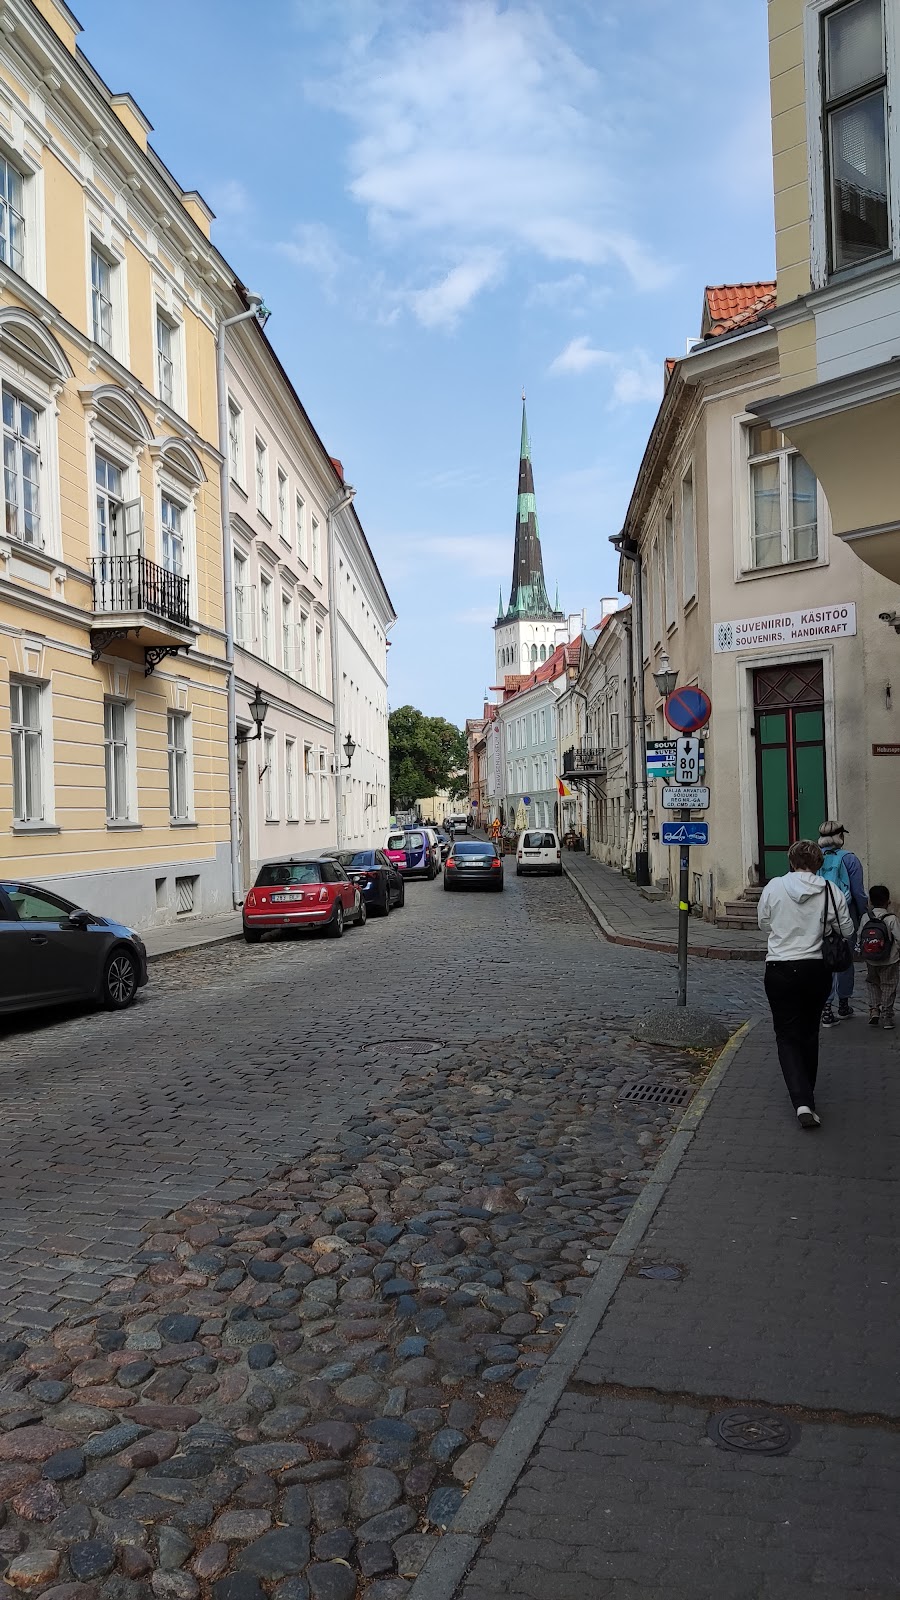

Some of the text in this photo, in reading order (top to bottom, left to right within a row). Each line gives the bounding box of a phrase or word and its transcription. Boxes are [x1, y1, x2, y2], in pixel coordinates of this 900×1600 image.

[735, 606, 848, 634] SUVENIIRID, KÄSITÖÖ
[791, 622, 848, 639] HANDIKRAFT
[680, 758, 695, 769] 80
[682, 771, 692, 779] m
